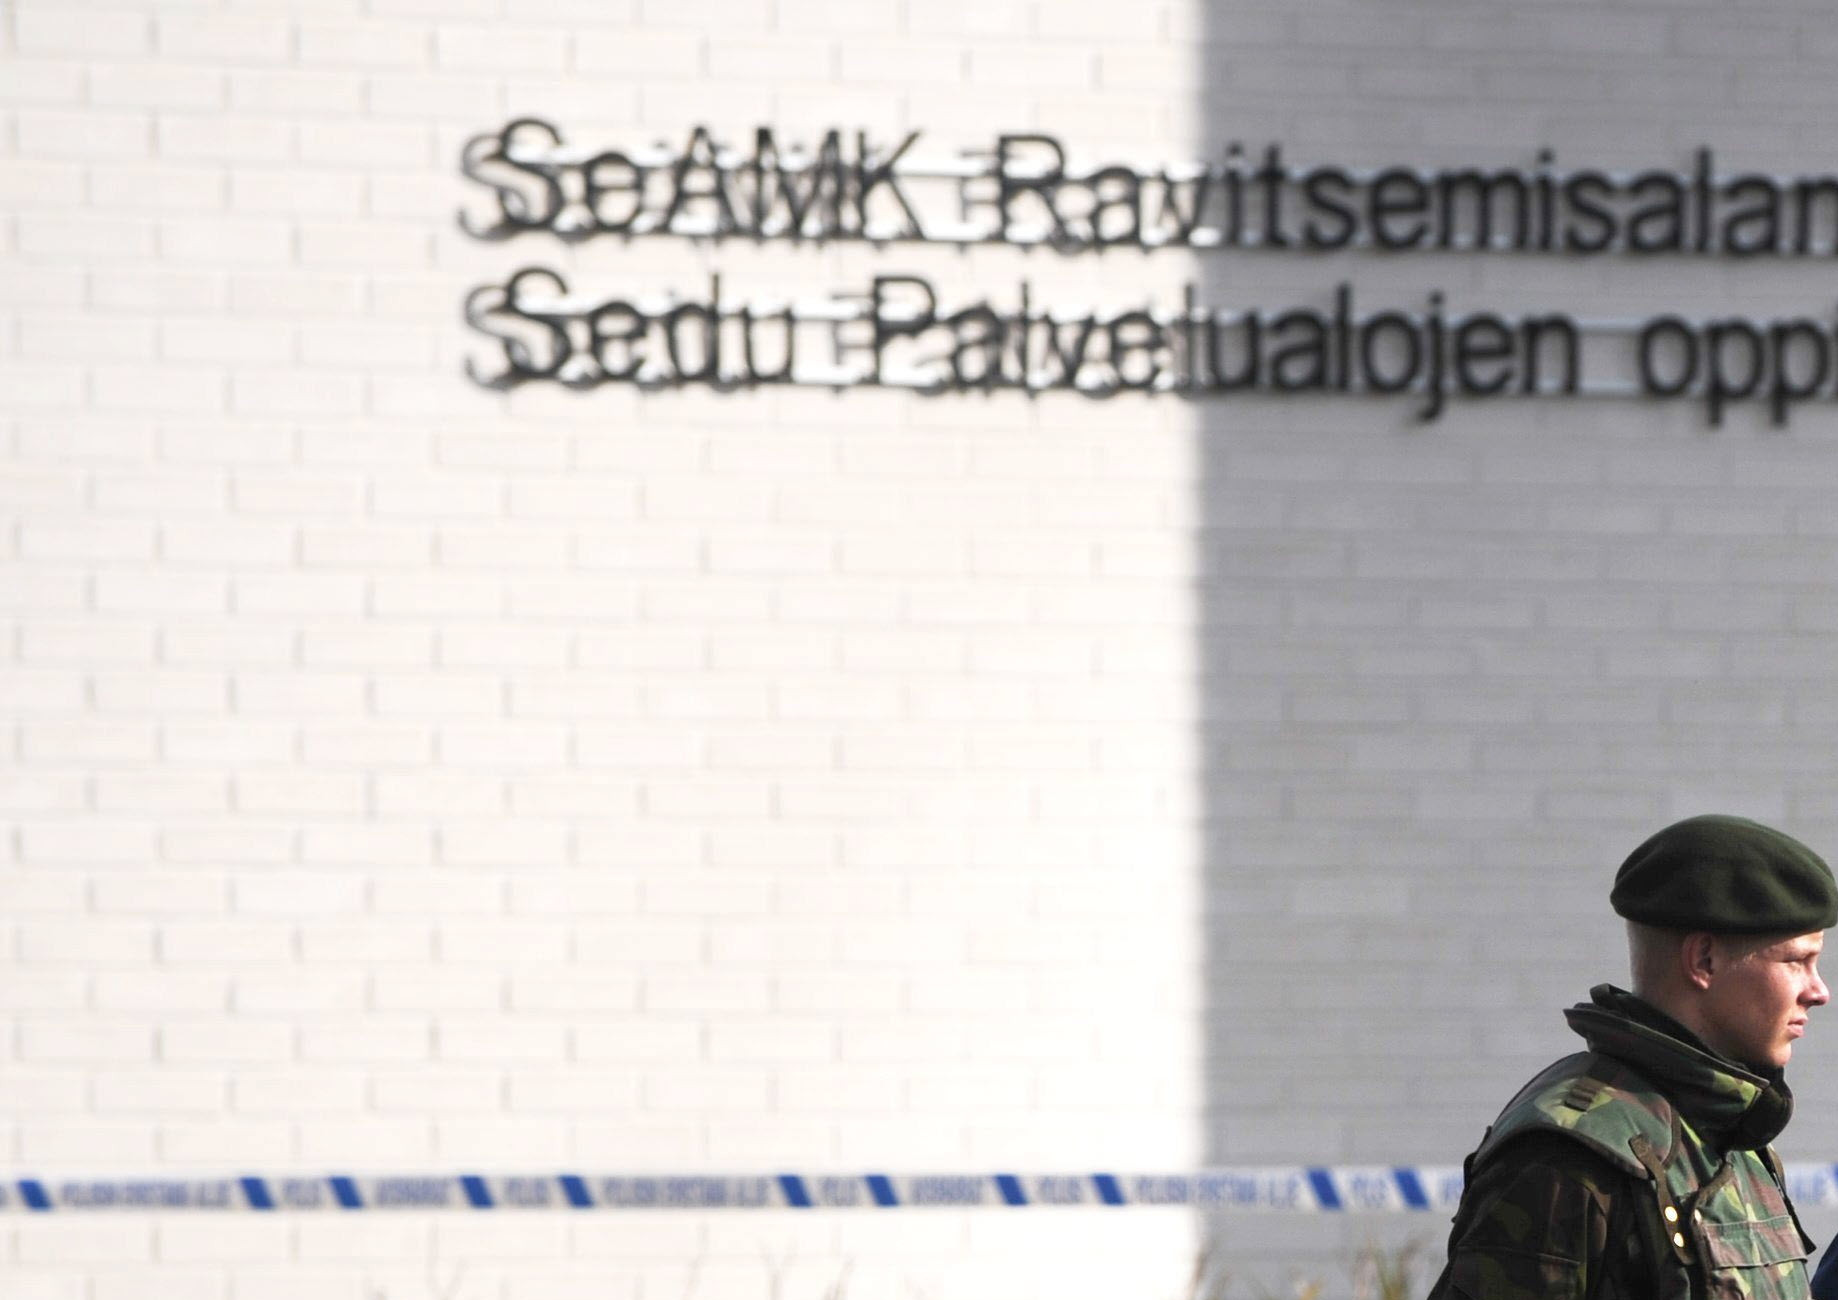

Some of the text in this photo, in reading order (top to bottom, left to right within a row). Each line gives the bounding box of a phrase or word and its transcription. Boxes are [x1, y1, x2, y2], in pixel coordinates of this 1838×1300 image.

[490, 115, 928, 238] SeAMK
[500, 266, 797, 390] Sedu
[872, 274, 1582, 425] Palvelualojen
